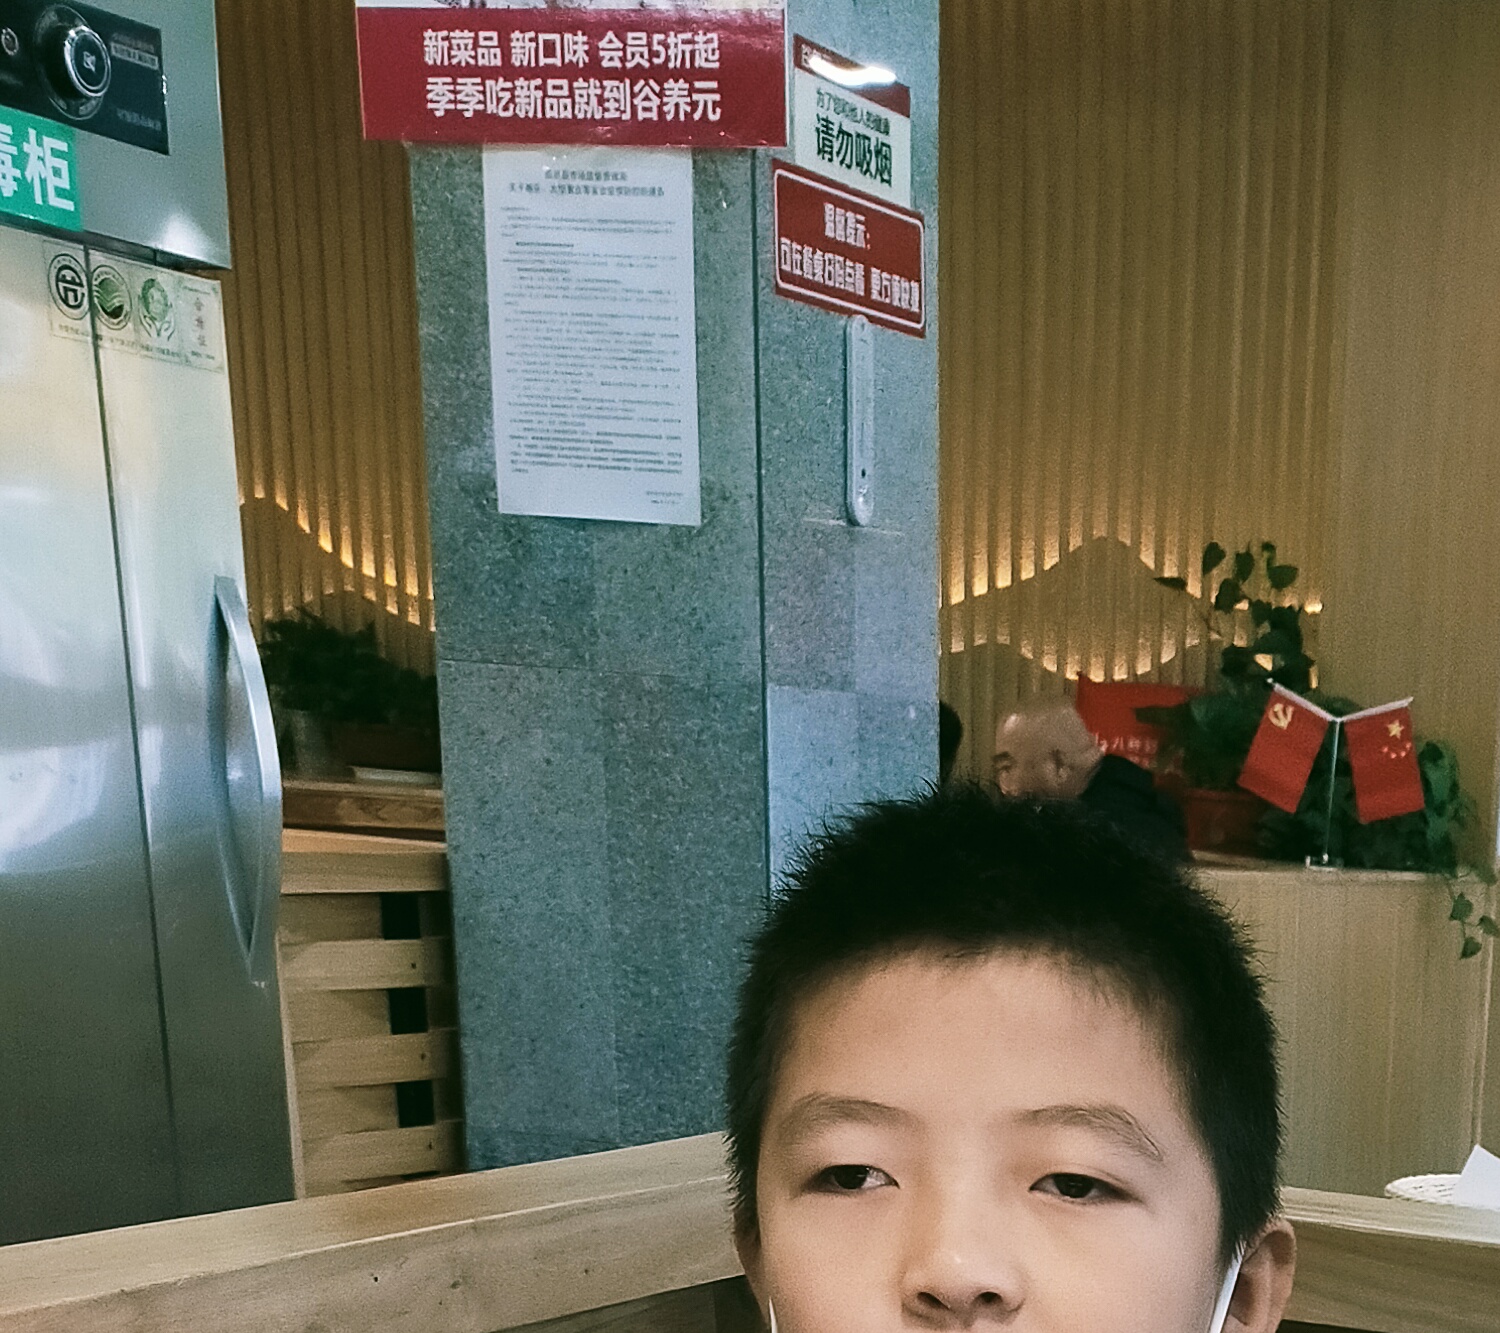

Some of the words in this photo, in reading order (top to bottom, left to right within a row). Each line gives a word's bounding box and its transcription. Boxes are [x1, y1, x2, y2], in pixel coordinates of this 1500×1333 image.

[423, 30, 500, 67] 新菜品
[510, 31, 589, 68] 新口味
[598, 32, 720, 69] 会员5折起
[426, 77, 721, 121] 季季吃新品就到谷养元
[815, 113, 892, 187] 请勿吸烟
